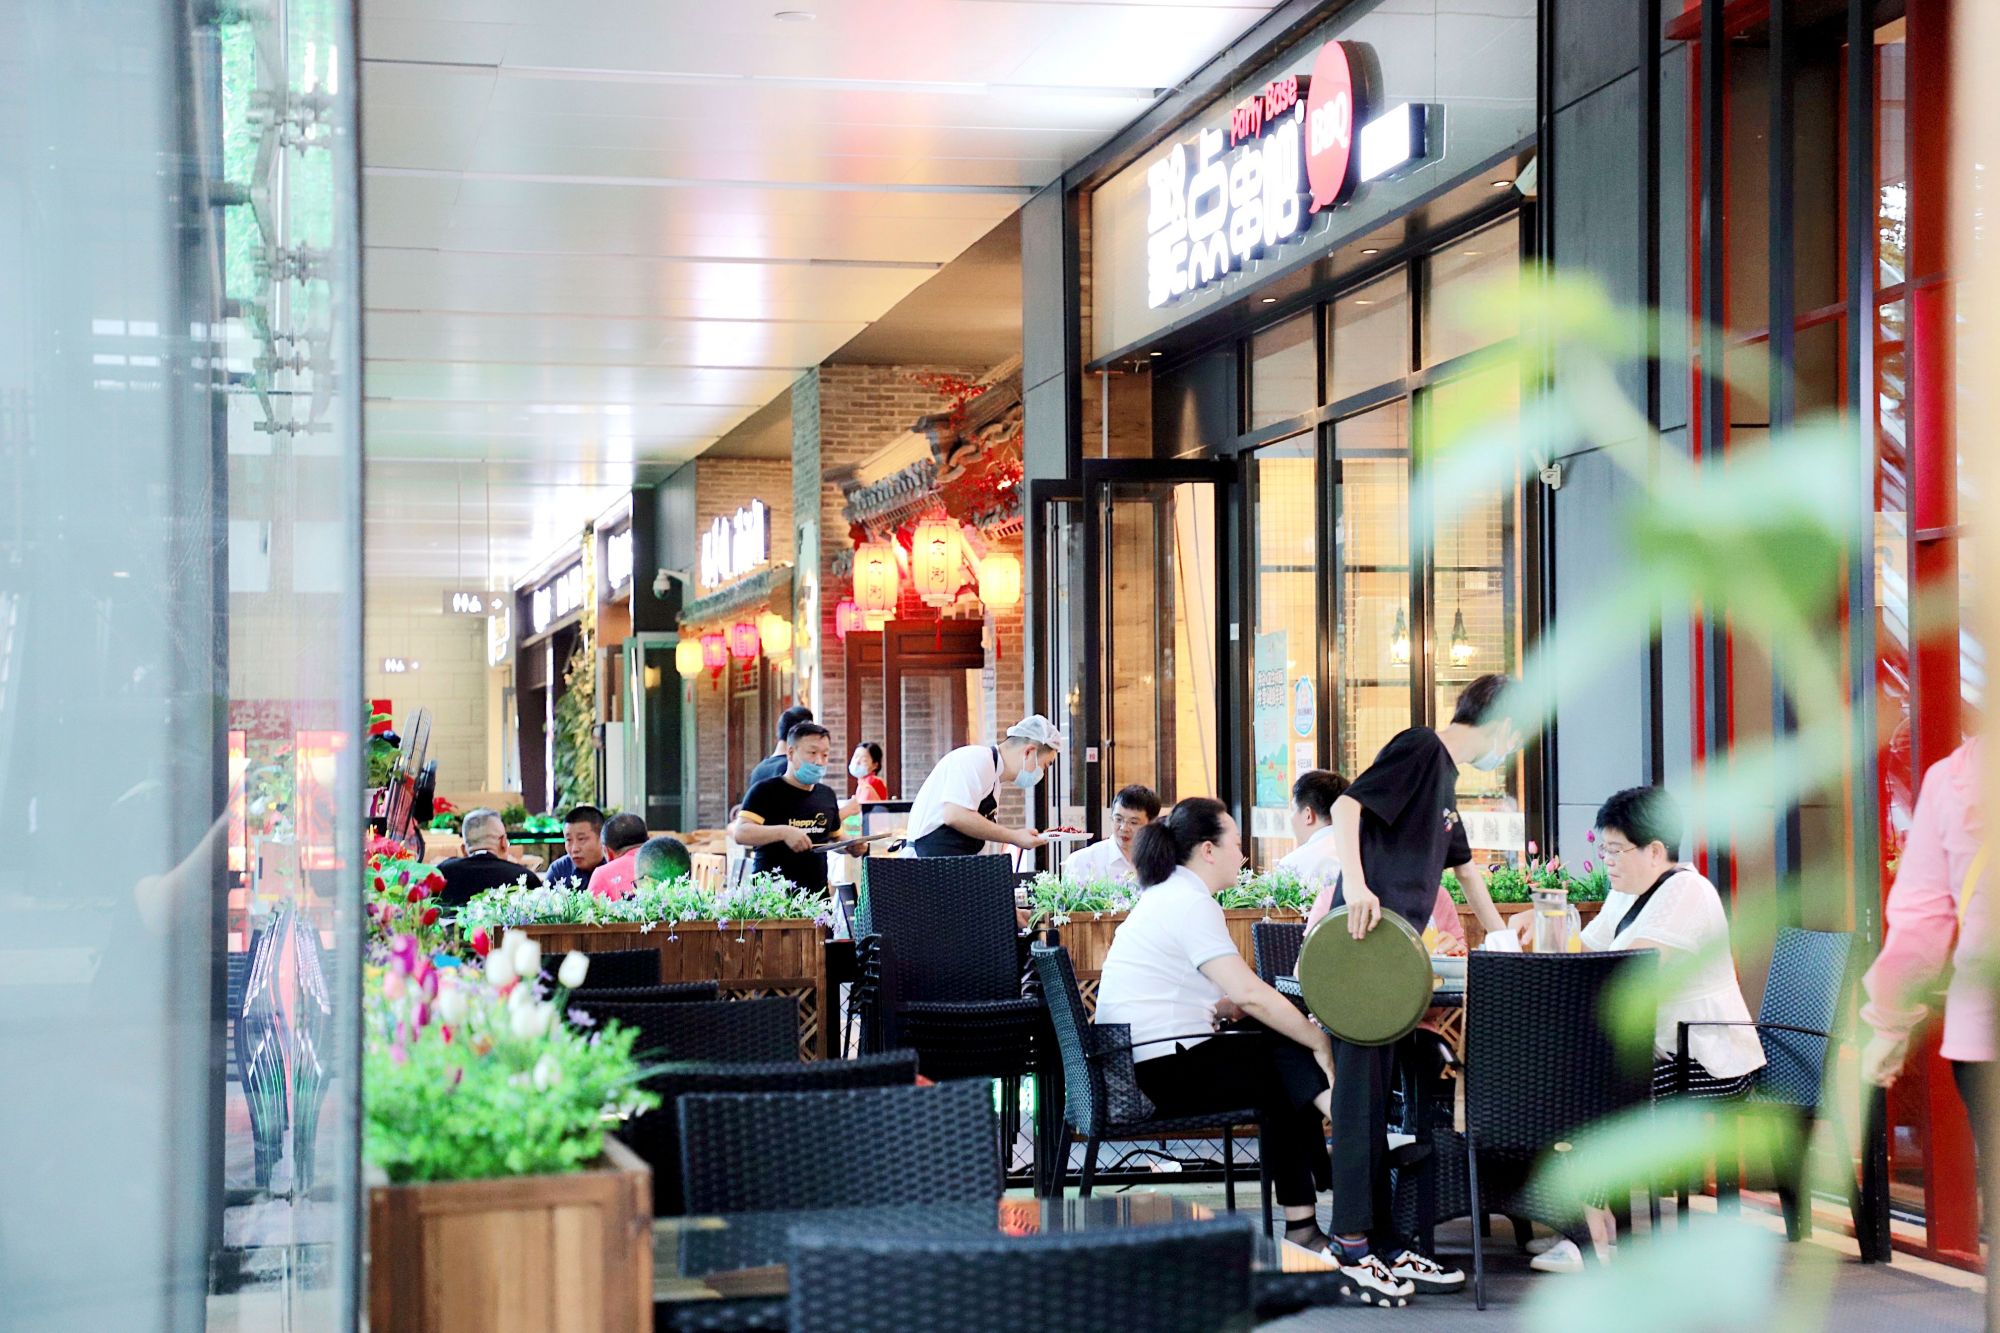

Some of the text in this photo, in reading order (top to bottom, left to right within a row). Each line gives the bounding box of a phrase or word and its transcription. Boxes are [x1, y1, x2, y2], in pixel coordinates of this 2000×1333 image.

[1229, 74, 1297, 148] Party Base
[1310, 91, 1349, 157] BBQ
